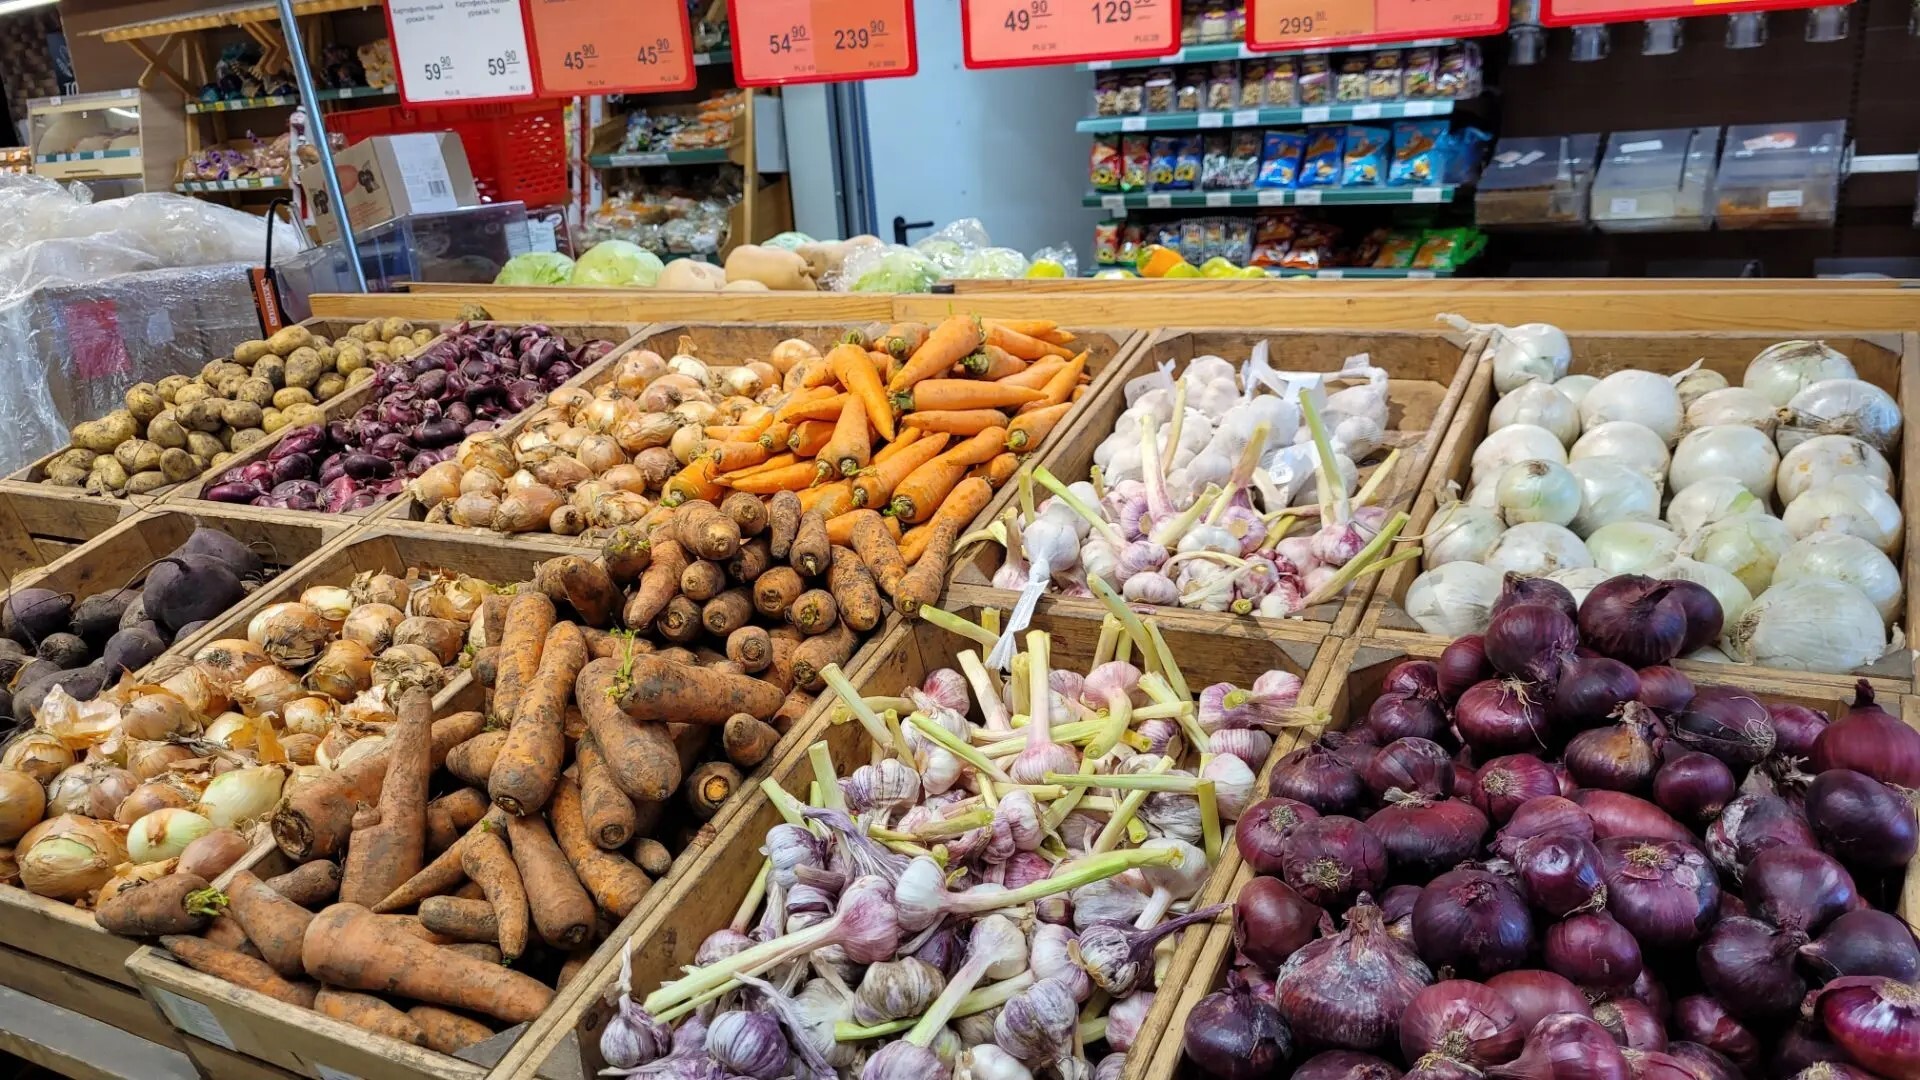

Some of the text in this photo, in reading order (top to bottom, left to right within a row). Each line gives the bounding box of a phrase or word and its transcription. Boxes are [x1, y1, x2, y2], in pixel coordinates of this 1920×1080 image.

[1004, 0, 1048, 32] 49 90
[1092, 0, 1133, 25] 129
[1279, 16, 1314, 35] 299
[769, 25, 806, 55] 54 90
[834, 20, 885, 51] 239 90
[488, 50, 516, 76] 59 90
[564, 44, 595, 70] 45 90
[638, 38, 669, 65] 45 90
[425, 56, 451, 81] 59 90
